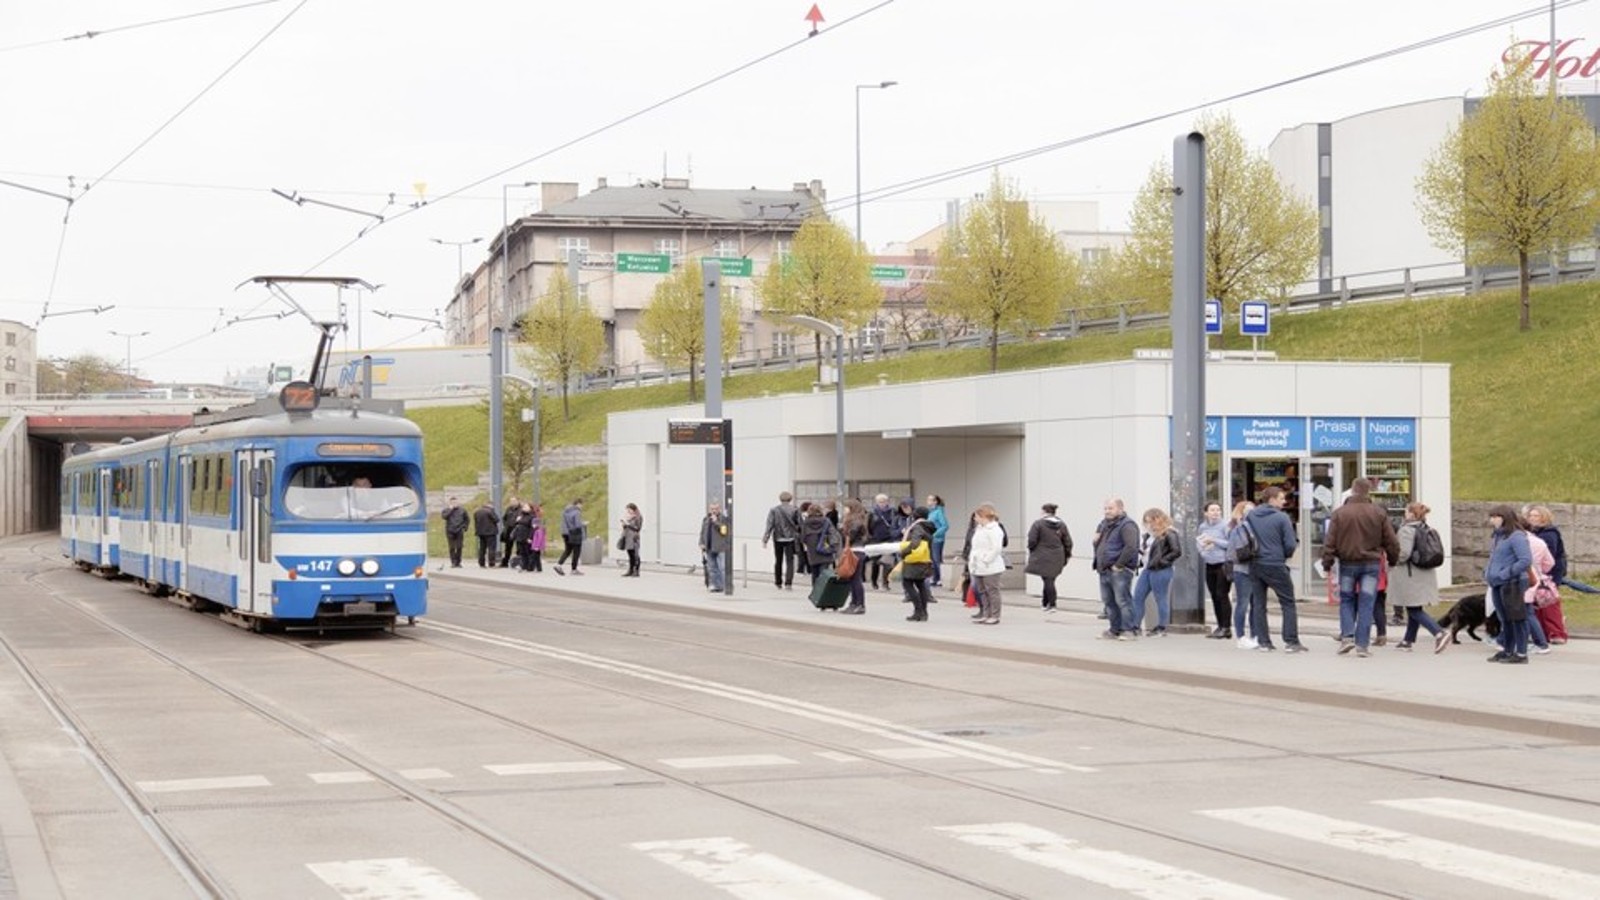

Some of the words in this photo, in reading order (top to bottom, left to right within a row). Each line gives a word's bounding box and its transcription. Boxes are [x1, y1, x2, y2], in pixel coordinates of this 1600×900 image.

[1252, 419, 1280, 428] Punkt
[1314, 420, 1356, 433] Prasa
[1369, 422, 1410, 436] Napoje
[1242, 428, 1290, 439] Informacji
[1245, 437, 1287, 448] Miejskiej
[1319, 436, 1351, 448] Press
[1375, 436, 1405, 446] Drinks
[310, 560, 333, 572] 147
